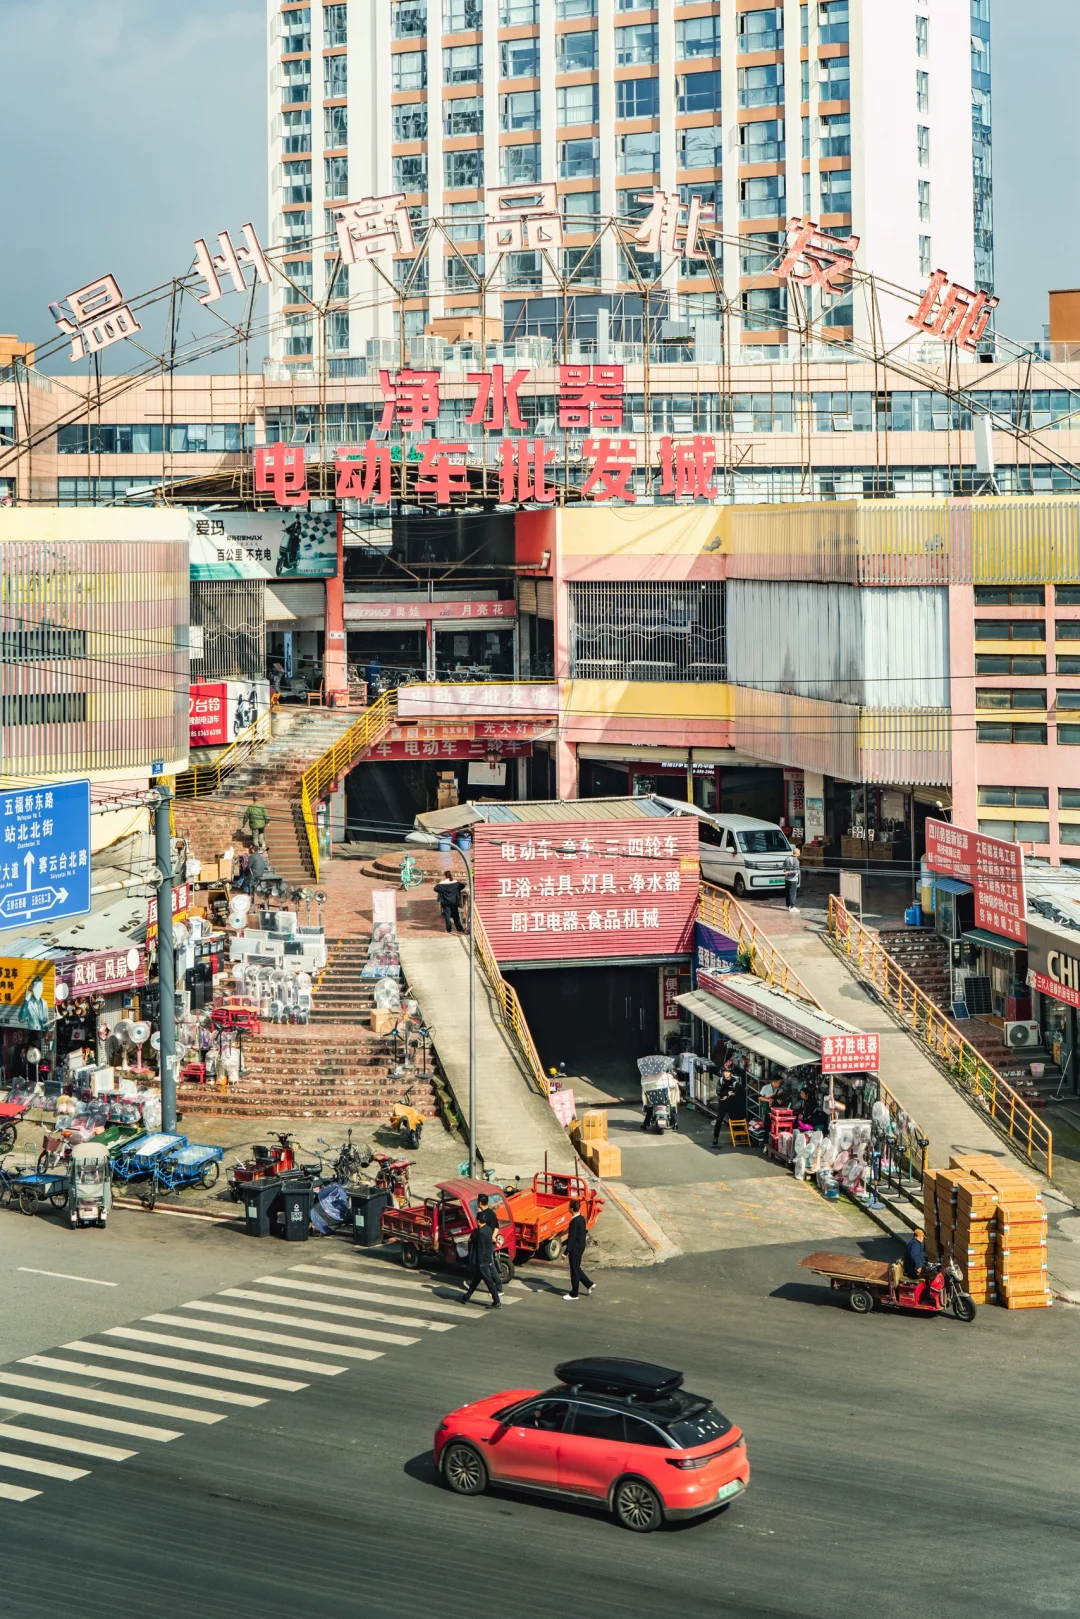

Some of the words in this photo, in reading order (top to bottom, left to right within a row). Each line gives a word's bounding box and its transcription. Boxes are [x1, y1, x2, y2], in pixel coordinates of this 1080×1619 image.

[48, 183, 1000, 362] 温州商品批发城
[379, 364, 624, 433] 净水器
[255, 436, 718, 506] 电动车批发城
[196, 520, 224, 535] 爱玛
[217, 548, 242, 561] 百公里
[246, 548, 271, 561] 不充电
[462, 603, 504, 616] 月亮花
[196, 697, 220, 713] 台铃
[411, 687, 549, 705] 电动车批发城
[404, 740, 457, 756] 电动车
[4, 791, 54, 815] 五福桥东路
[793, 783, 804, 810] 汉邦
[5, 819, 54, 843] 站北北街
[38, 848, 87, 874] 赛云台北路
[976, 840, 1016, 866] 太阳能发电工程
[0, 862, 19, 881] 大道
[977, 857, 1017, 882] 太阳能热水工程
[978, 875, 1018, 900] 空气能热水工程
[511, 908, 660, 932] 厨卫电器、食品机械
[980, 908, 1021, 935] 各种地暖工程
[74, 961, 98, 986] 风机
[105, 956, 127, 980] 风扇
[665, 977, 678, 1017] 便利店
[823, 1035, 878, 1055] 鑫齐胜电器
